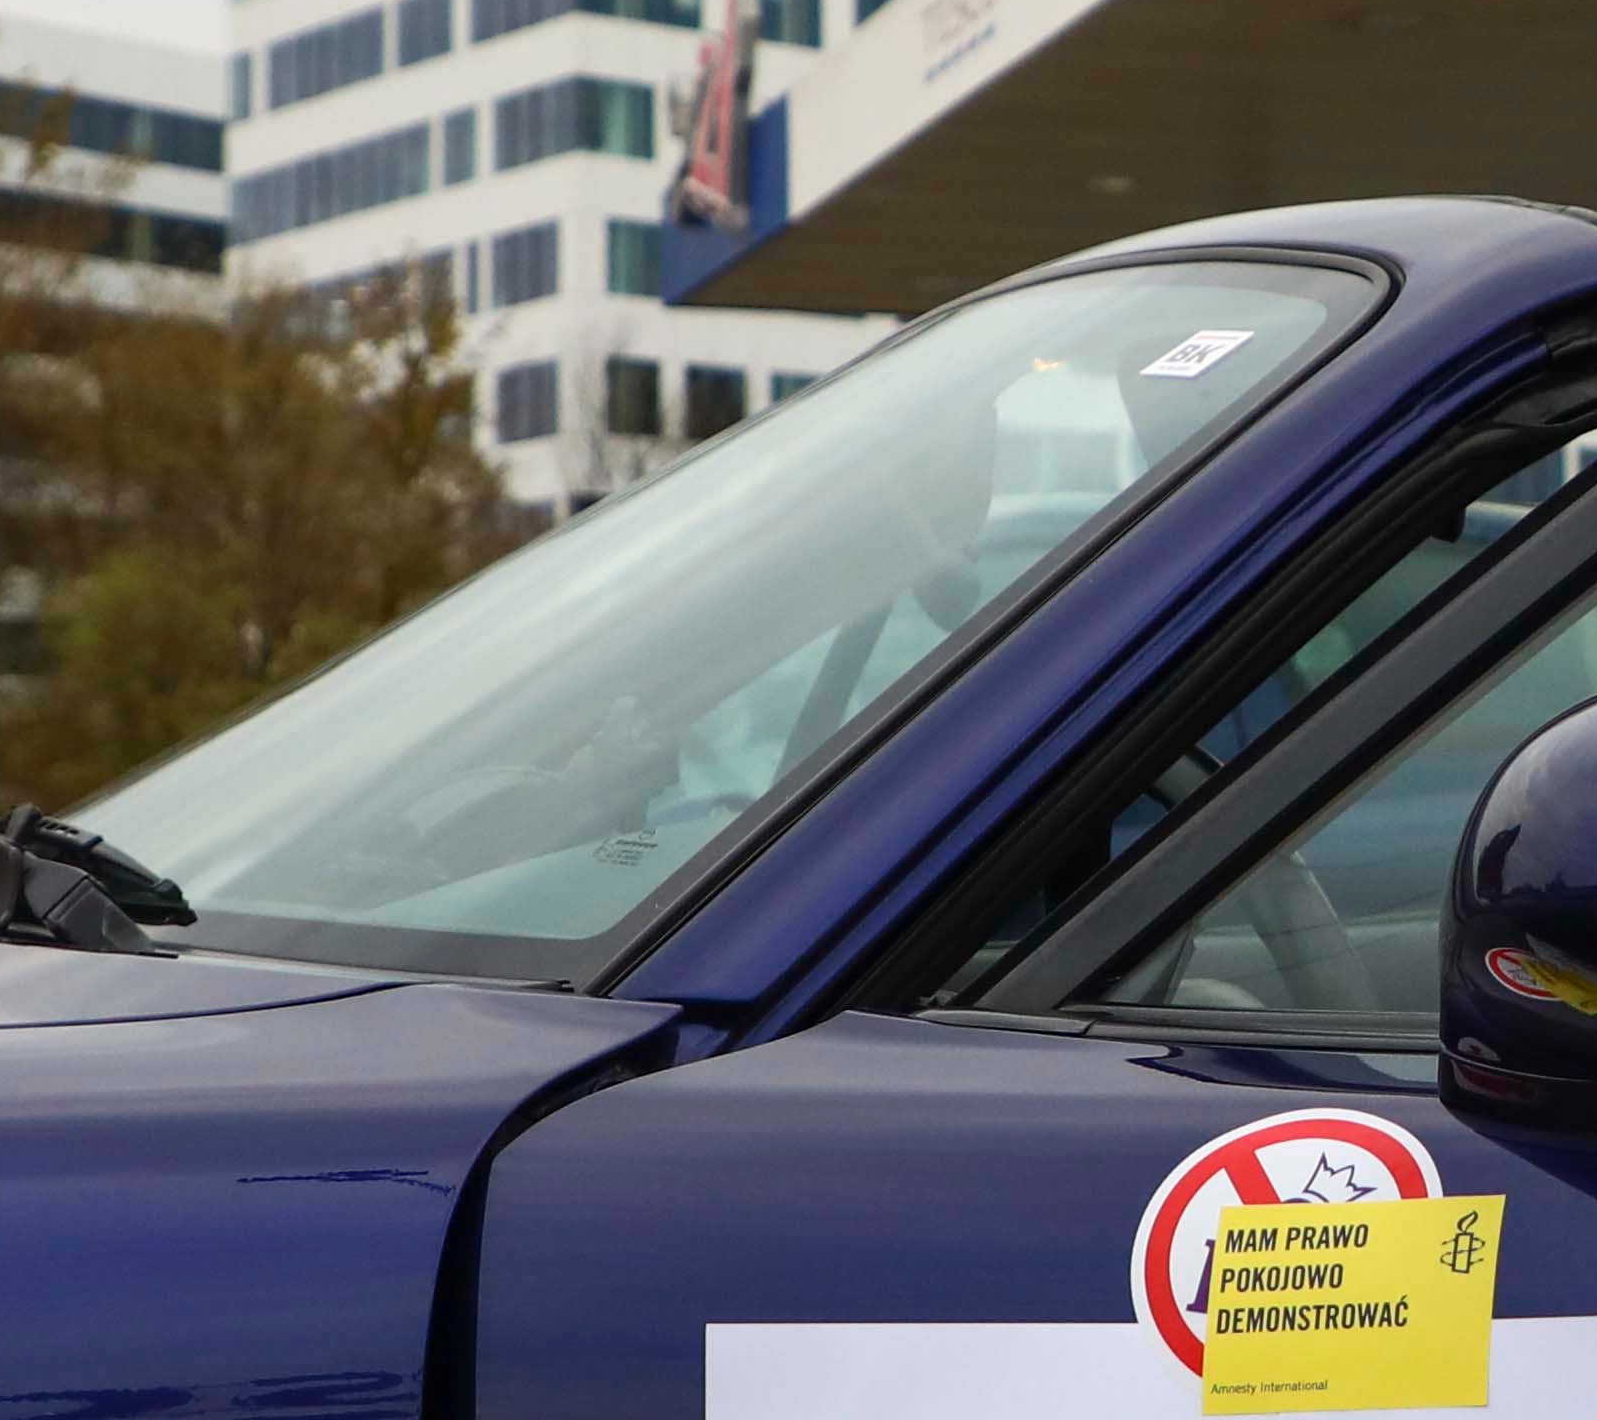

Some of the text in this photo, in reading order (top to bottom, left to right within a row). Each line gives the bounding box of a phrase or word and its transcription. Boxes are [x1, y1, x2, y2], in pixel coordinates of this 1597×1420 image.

[1225, 1224, 1369, 1253] MAM PRAWO
[1220, 1263, 1344, 1293] POKOJOWO
[1216, 1295, 1409, 1334] DEMONSTROWAĆ
[1210, 1379, 1329, 1396] Amnesty International
